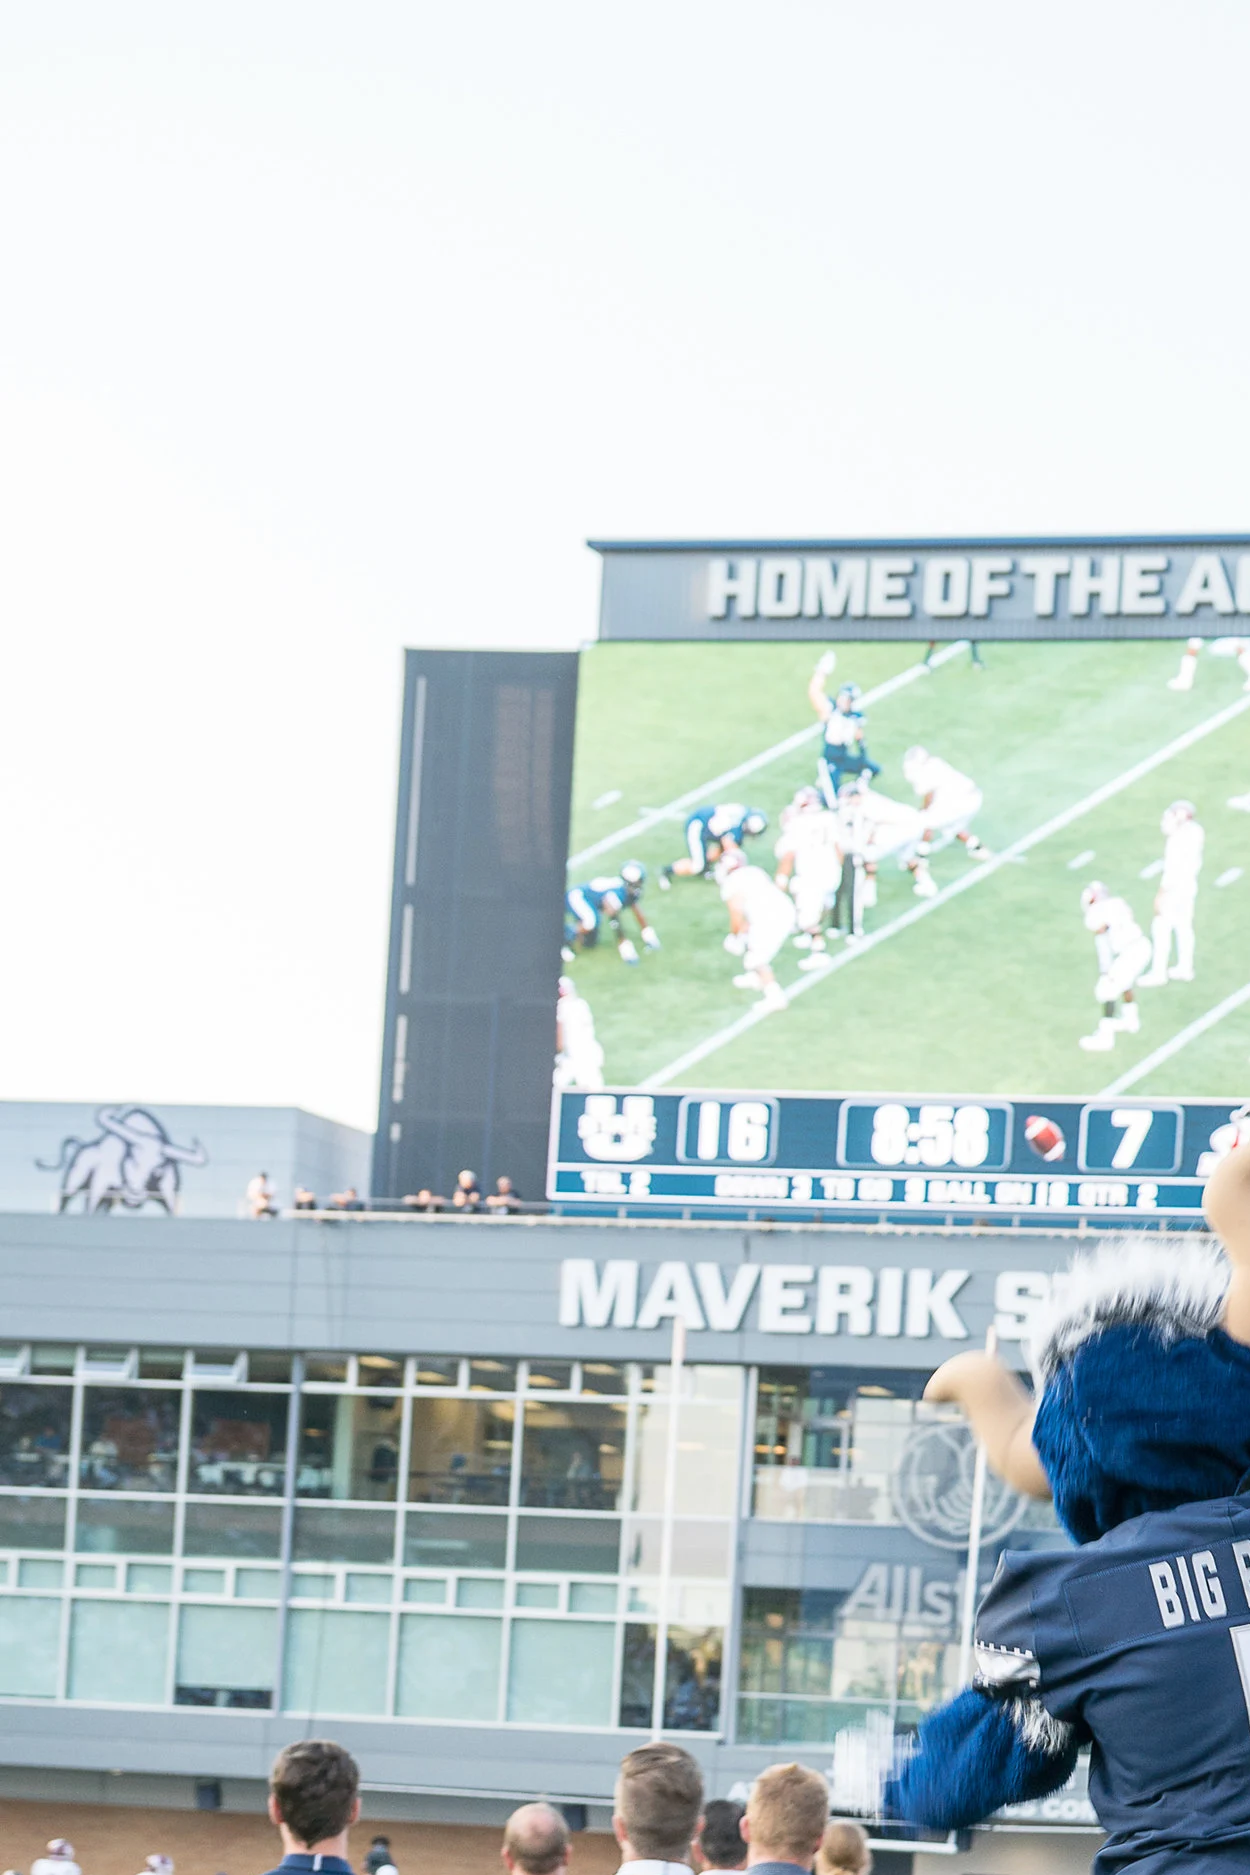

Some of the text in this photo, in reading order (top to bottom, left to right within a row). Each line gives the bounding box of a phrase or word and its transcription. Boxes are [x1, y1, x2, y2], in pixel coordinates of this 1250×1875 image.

[706, 557, 915, 619] HOME
[921, 556, 1014, 618] OF
[1020, 554, 1168, 617] THE
[697, 1101, 771, 1161] 16
[1110, 1108, 1154, 1170] 7
[556, 1257, 972, 1340] MAVERIK
[1148, 1550, 1227, 1630] BIG
